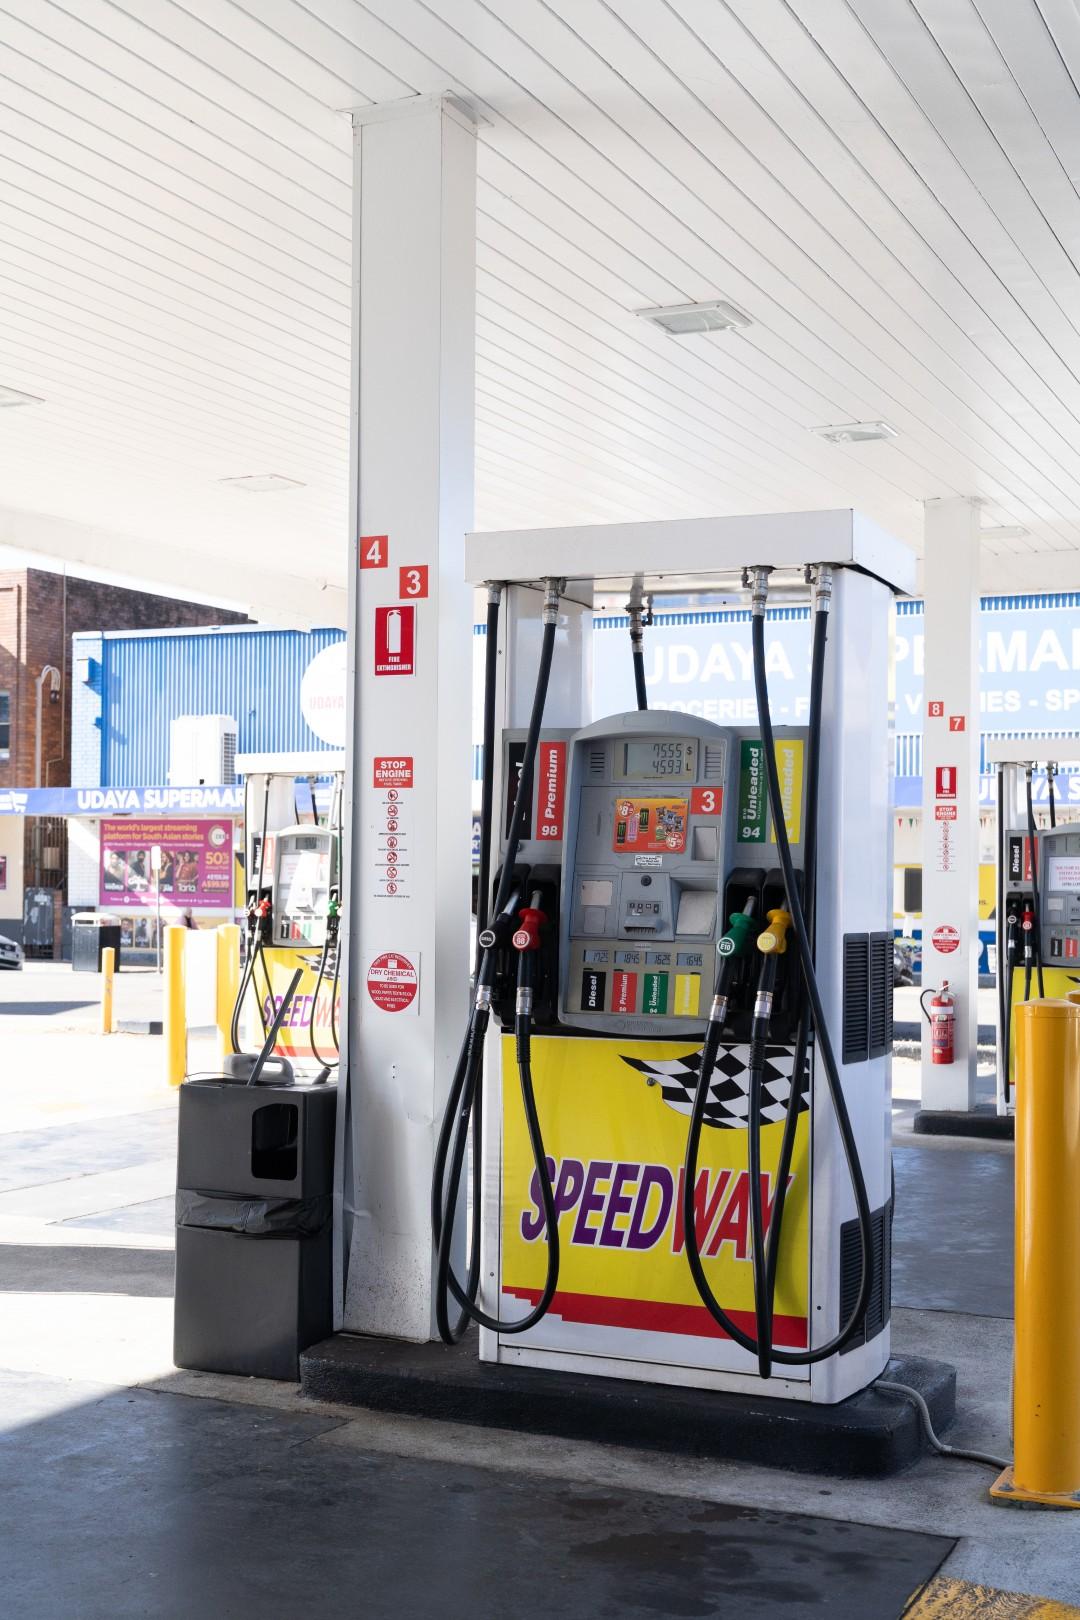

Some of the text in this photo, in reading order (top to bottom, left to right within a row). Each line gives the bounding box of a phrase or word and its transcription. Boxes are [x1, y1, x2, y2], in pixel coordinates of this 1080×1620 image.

[366, 540, 381, 565] 4
[406, 569, 421, 595] 3
[932, 703, 940, 715] 8
[953, 718, 961, 730] 7
[375, 769, 412, 778] ENGINE
[380, 760, 407, 769] STOP
[686, 762, 692, 771] L
[541, 749, 558, 836] 98 Premium
[742, 747, 760, 838] 94 Unleaded
[783, 748, 794, 820] Unleaded
[77, 790, 141, 810] UDAYA
[701, 790, 716, 812] 3
[103, 823, 198, 833] The world's largest streaming
[103, 832, 132, 841] platform
[133, 832, 141, 840] for
[183, 833, 204, 841] stories
[1012, 845, 1020, 873] Diesel
[383, 970, 415, 978] CHEMICAL
[588, 975, 598, 1007] Diesel
[619, 974, 628, 1005] Premium
